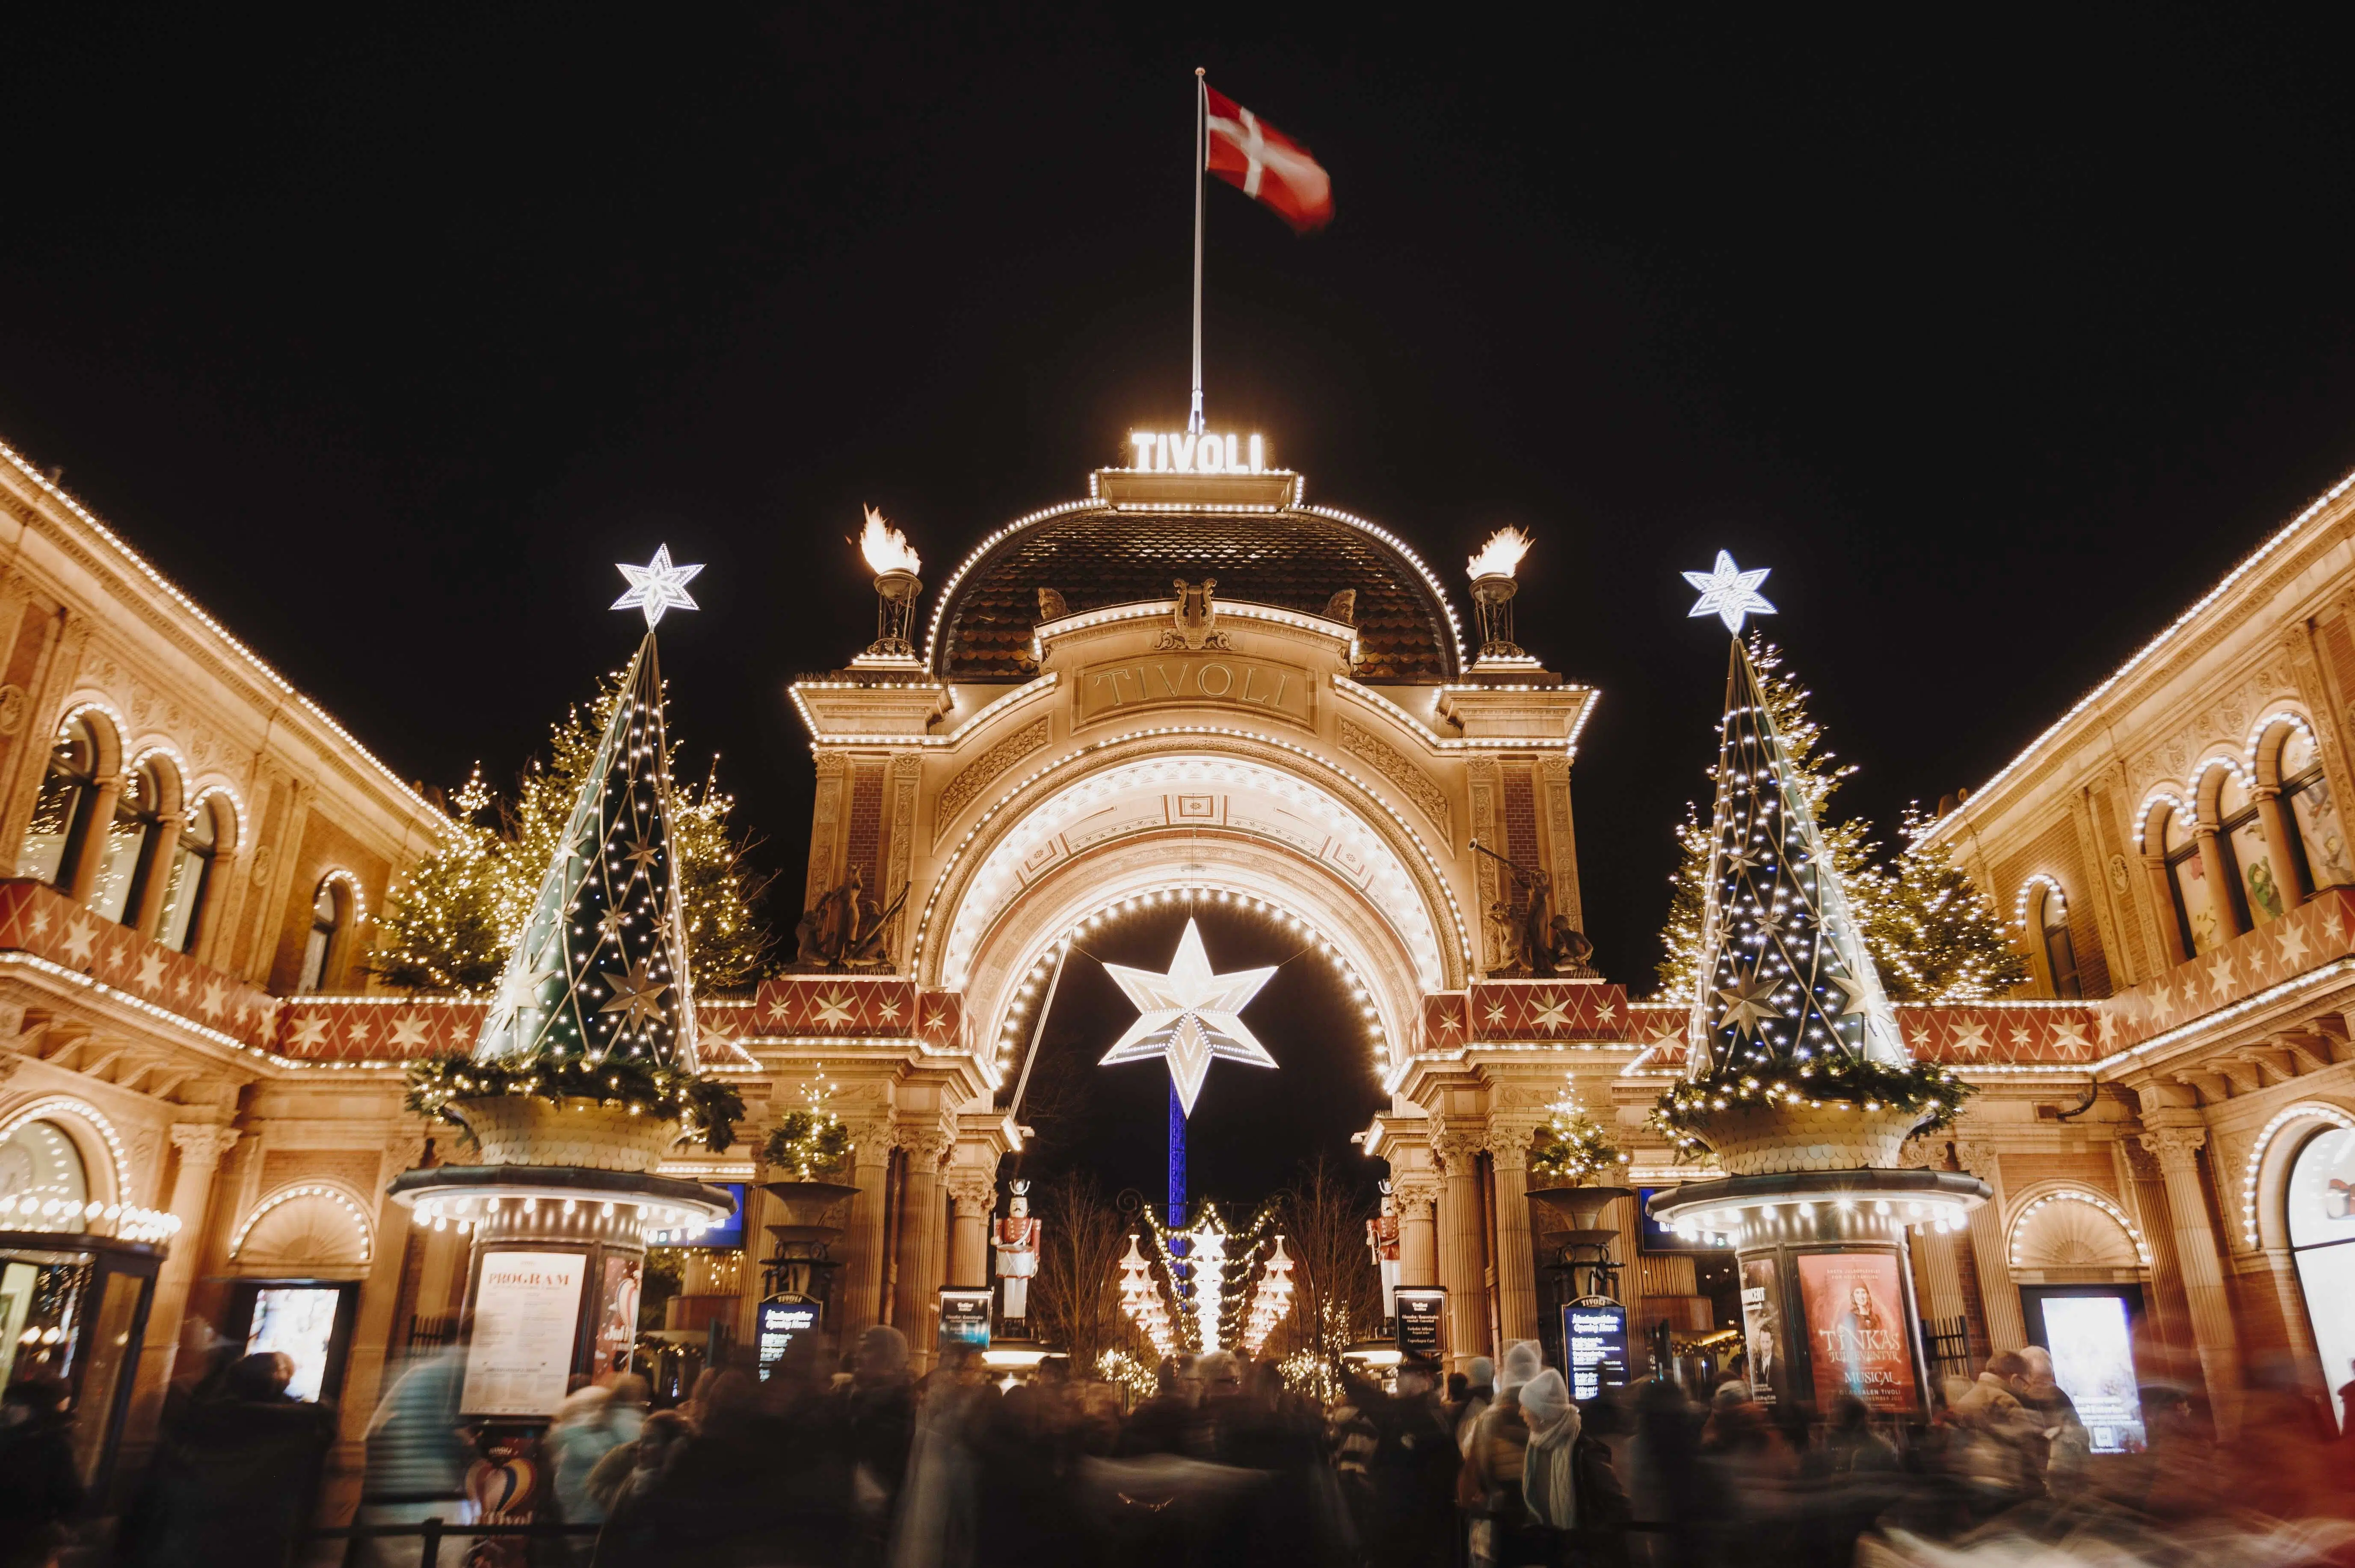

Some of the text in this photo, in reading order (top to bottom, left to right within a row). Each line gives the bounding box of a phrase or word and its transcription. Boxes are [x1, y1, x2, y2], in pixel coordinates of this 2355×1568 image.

[1132, 433, 1262, 472] TIVOLI
[1094, 663, 1291, 708] TIVOLI
[488, 1273, 569, 1286] PROGRAM
[777, 1295, 803, 1303] TIVOLI
[1581, 1298, 1606, 1307] TIVOLI
[1819, 1324, 1900, 1351] TINKAS
[1844, 1372, 1902, 1386] MUSICAL
